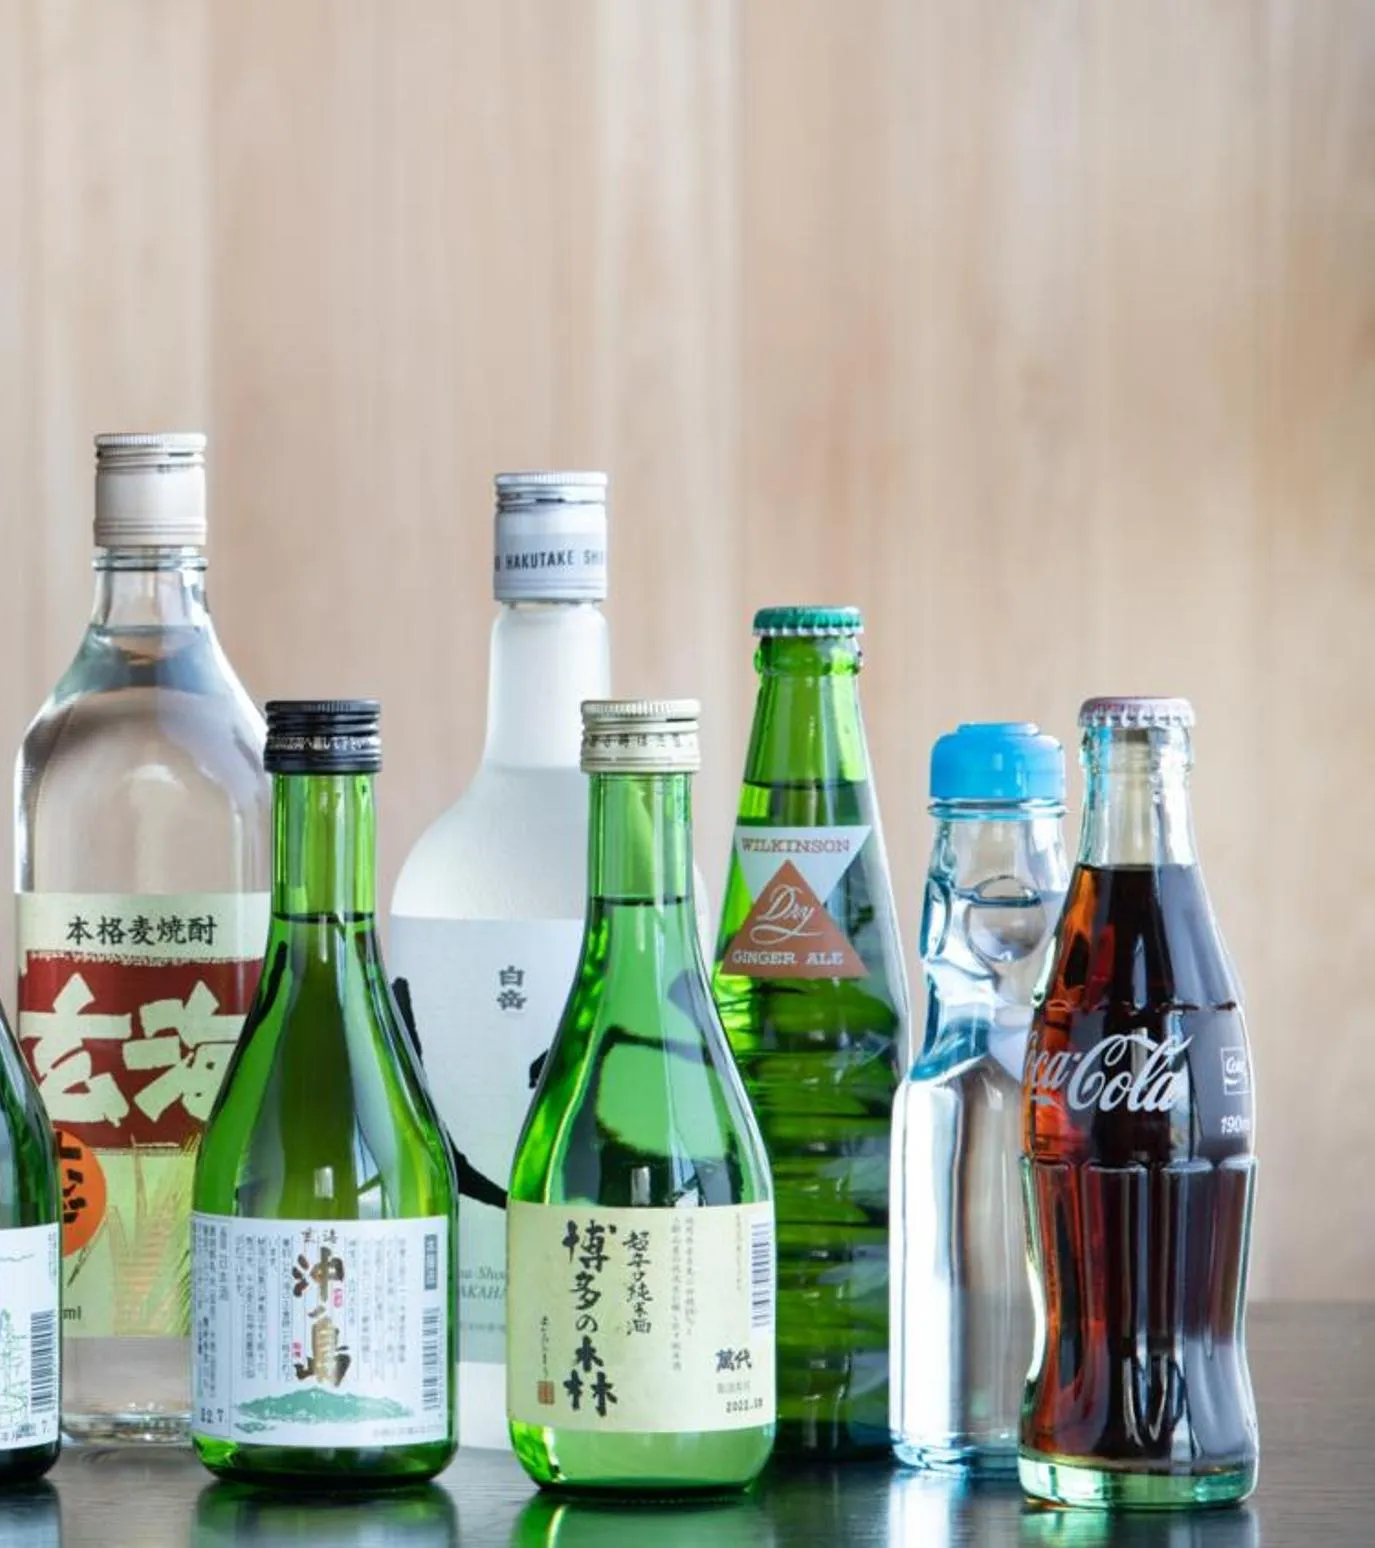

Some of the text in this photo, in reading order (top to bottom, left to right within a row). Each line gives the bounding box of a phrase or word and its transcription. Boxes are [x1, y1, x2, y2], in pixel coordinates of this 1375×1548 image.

[505, 549, 575, 571] HAKUTAKE
[741, 837, 851, 853] WILKINSON
[749, 883, 825, 946] Dry
[65, 914, 218, 946] 本格麦焼酎
[731, 950, 844, 966] GINGER ALE
[497, 965, 527, 1011] 白岳
